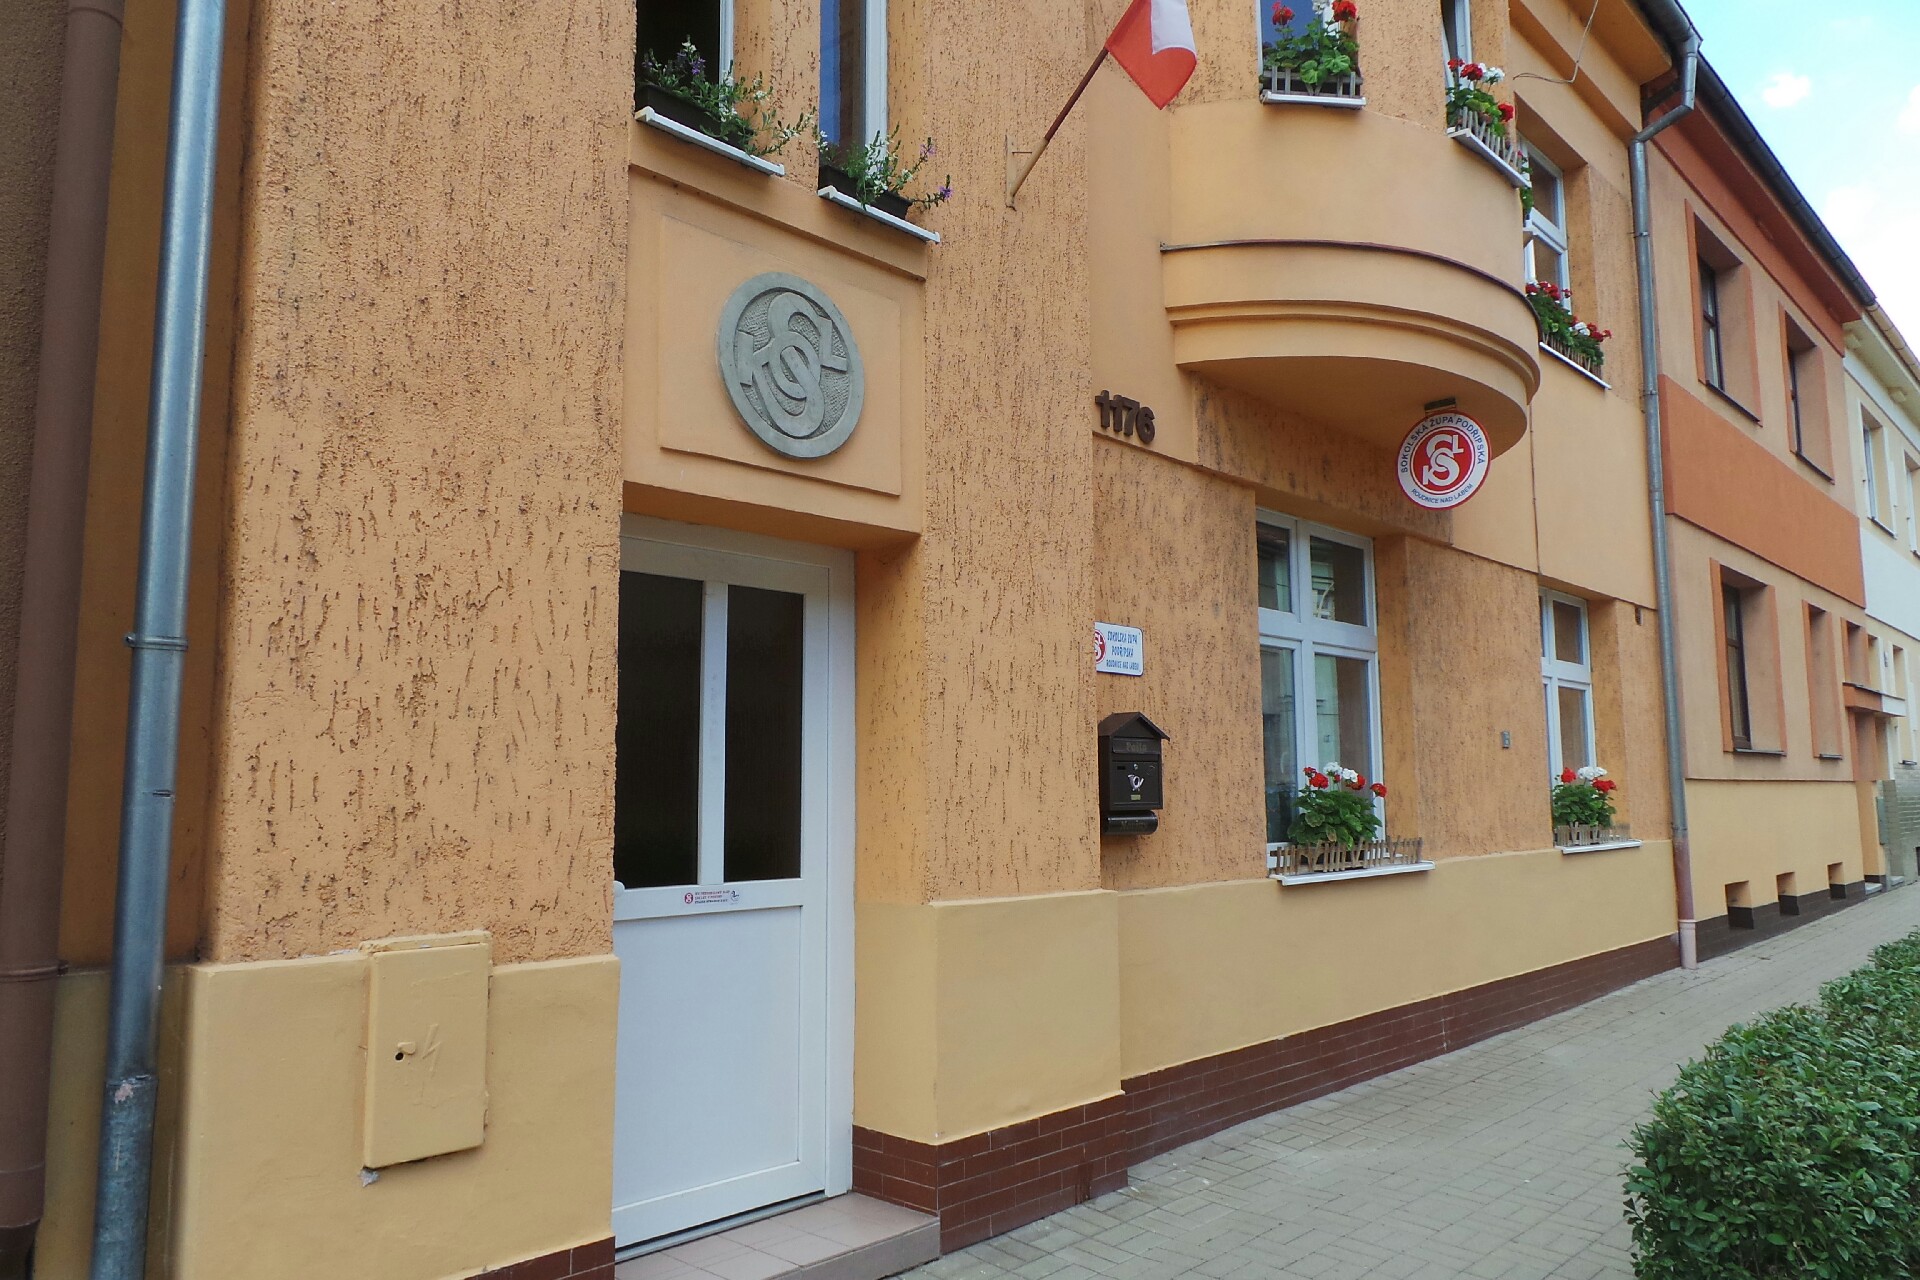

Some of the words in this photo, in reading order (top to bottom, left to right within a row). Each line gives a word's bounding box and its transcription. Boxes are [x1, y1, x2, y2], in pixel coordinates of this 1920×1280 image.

[1095, 390, 1155, 444] 1176
[1411, 488, 1439, 504] ROUDNICE
[1454, 483, 1474, 499] LABEM
